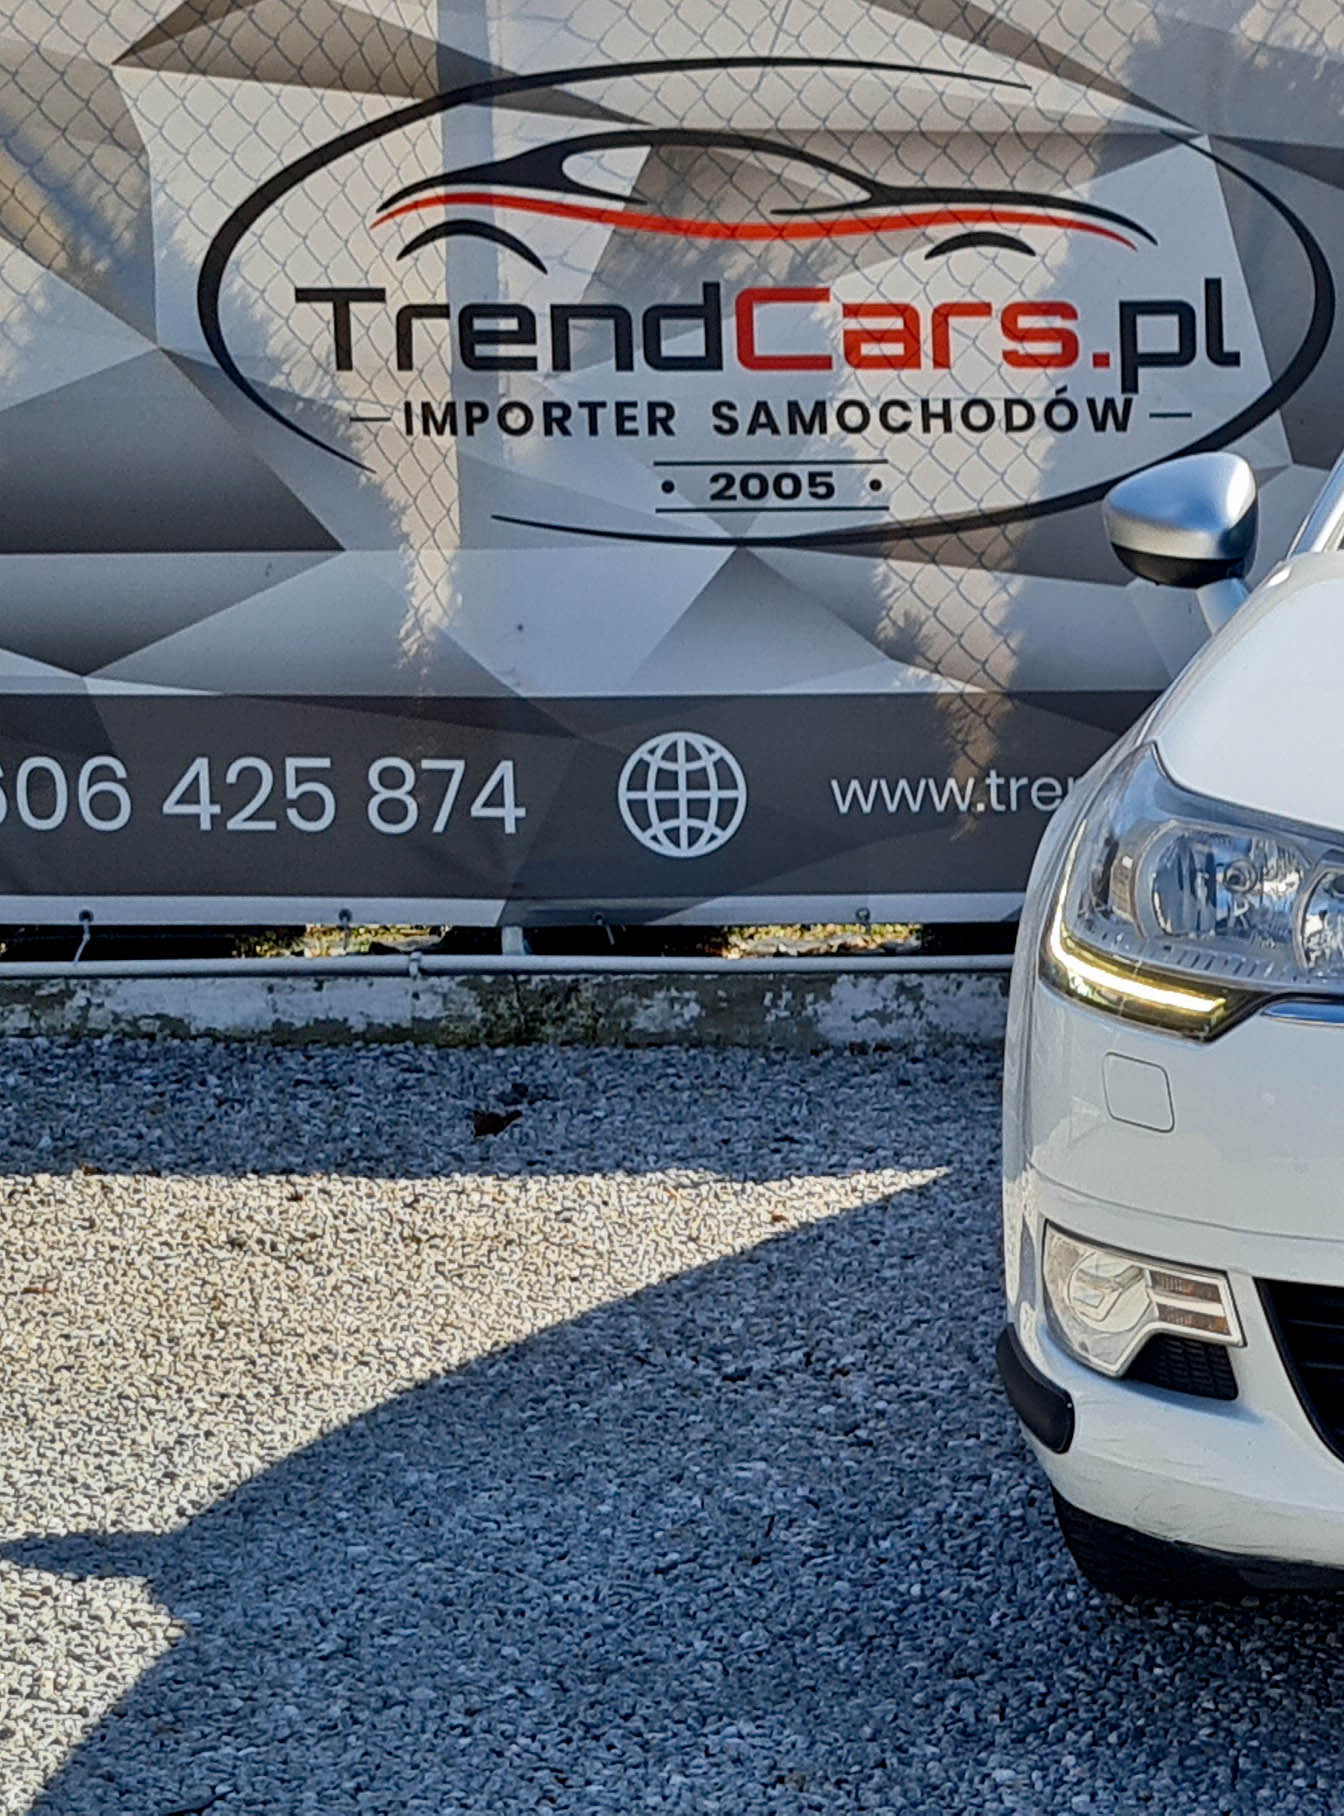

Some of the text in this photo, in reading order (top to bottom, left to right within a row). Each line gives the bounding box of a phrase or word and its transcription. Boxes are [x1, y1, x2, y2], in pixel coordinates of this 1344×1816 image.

[294, 277, 1241, 394] TrendCars.pl
[403, 385, 1134, 438] IMPORTER SAMOCHODÓW
[708, 470, 836, 503] 2005
[0, 755, 526, 834] 06 425 874
[831, 769, 1076, 814] www.tre
